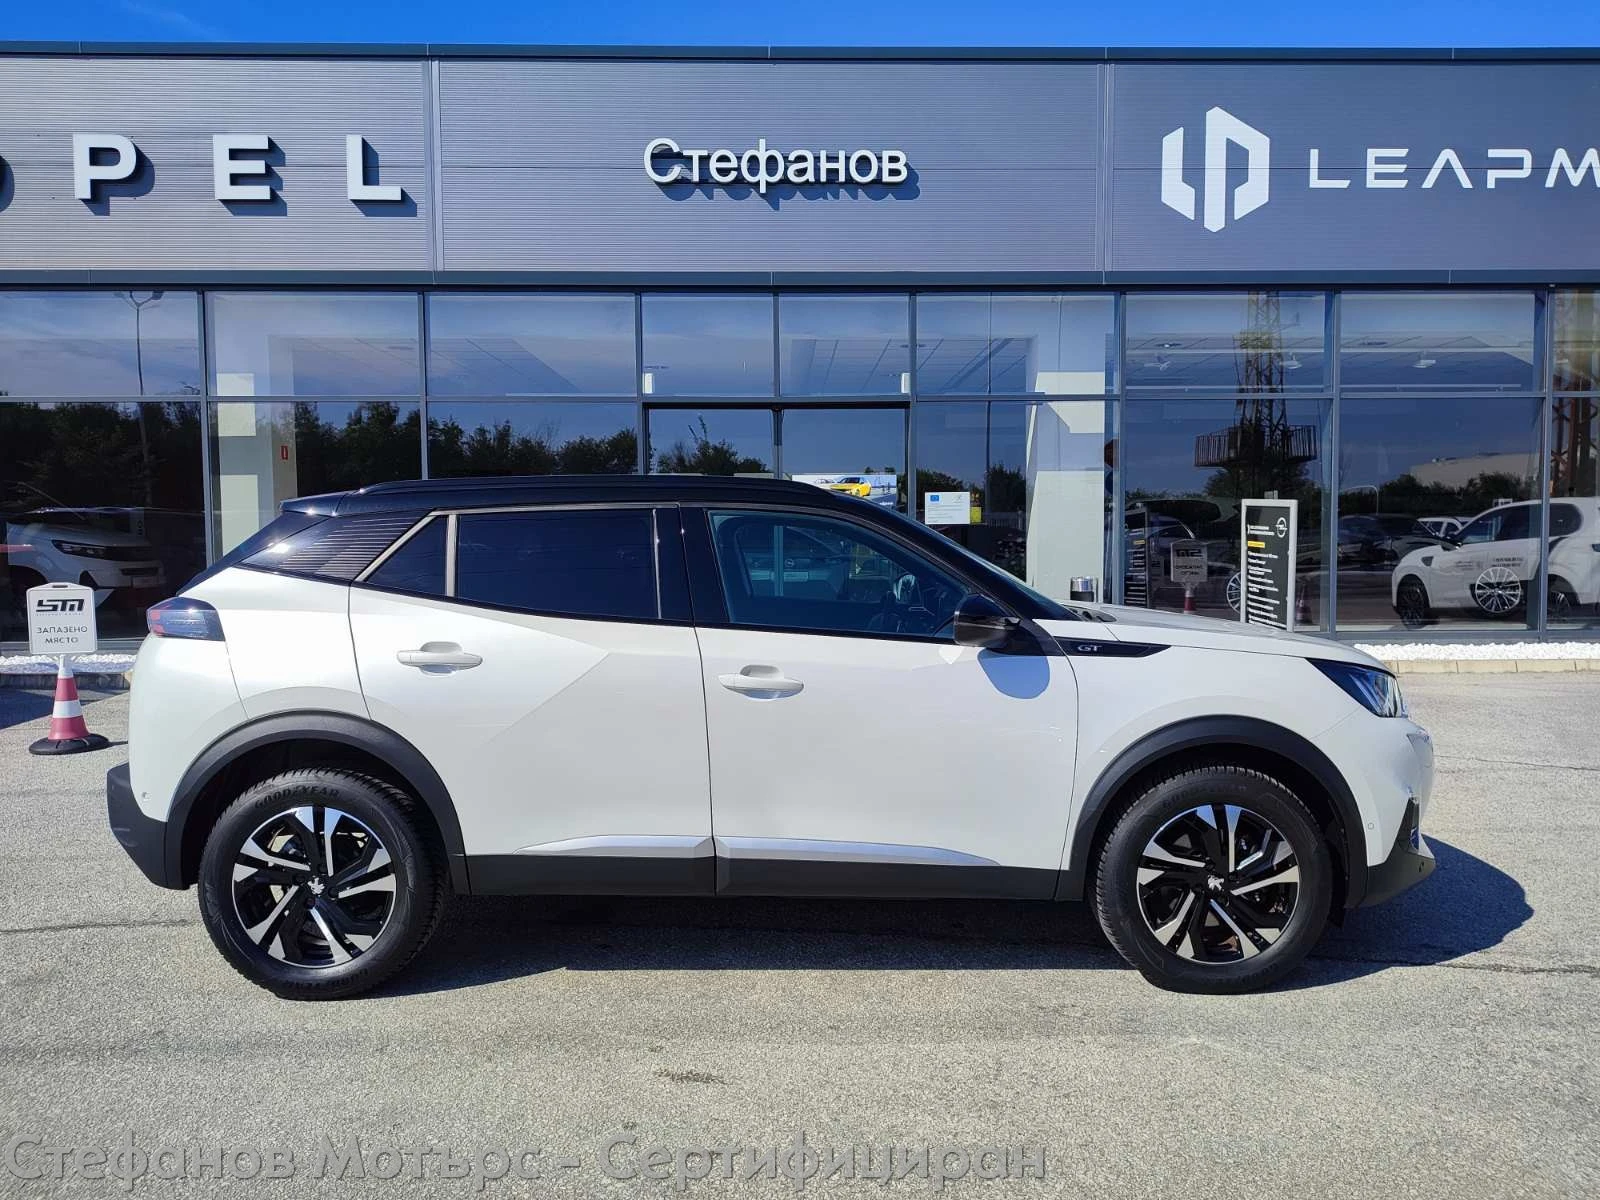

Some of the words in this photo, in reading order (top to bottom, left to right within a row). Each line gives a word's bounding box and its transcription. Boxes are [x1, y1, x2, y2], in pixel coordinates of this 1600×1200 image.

[73, 133, 402, 201] PEL
[643, 137, 909, 194] Стефанов
[36, 625, 88, 634] ЗАПАЗЕНО
[45, 636, 79, 644] МЯСТО
[1077, 644, 1102, 652] GT
